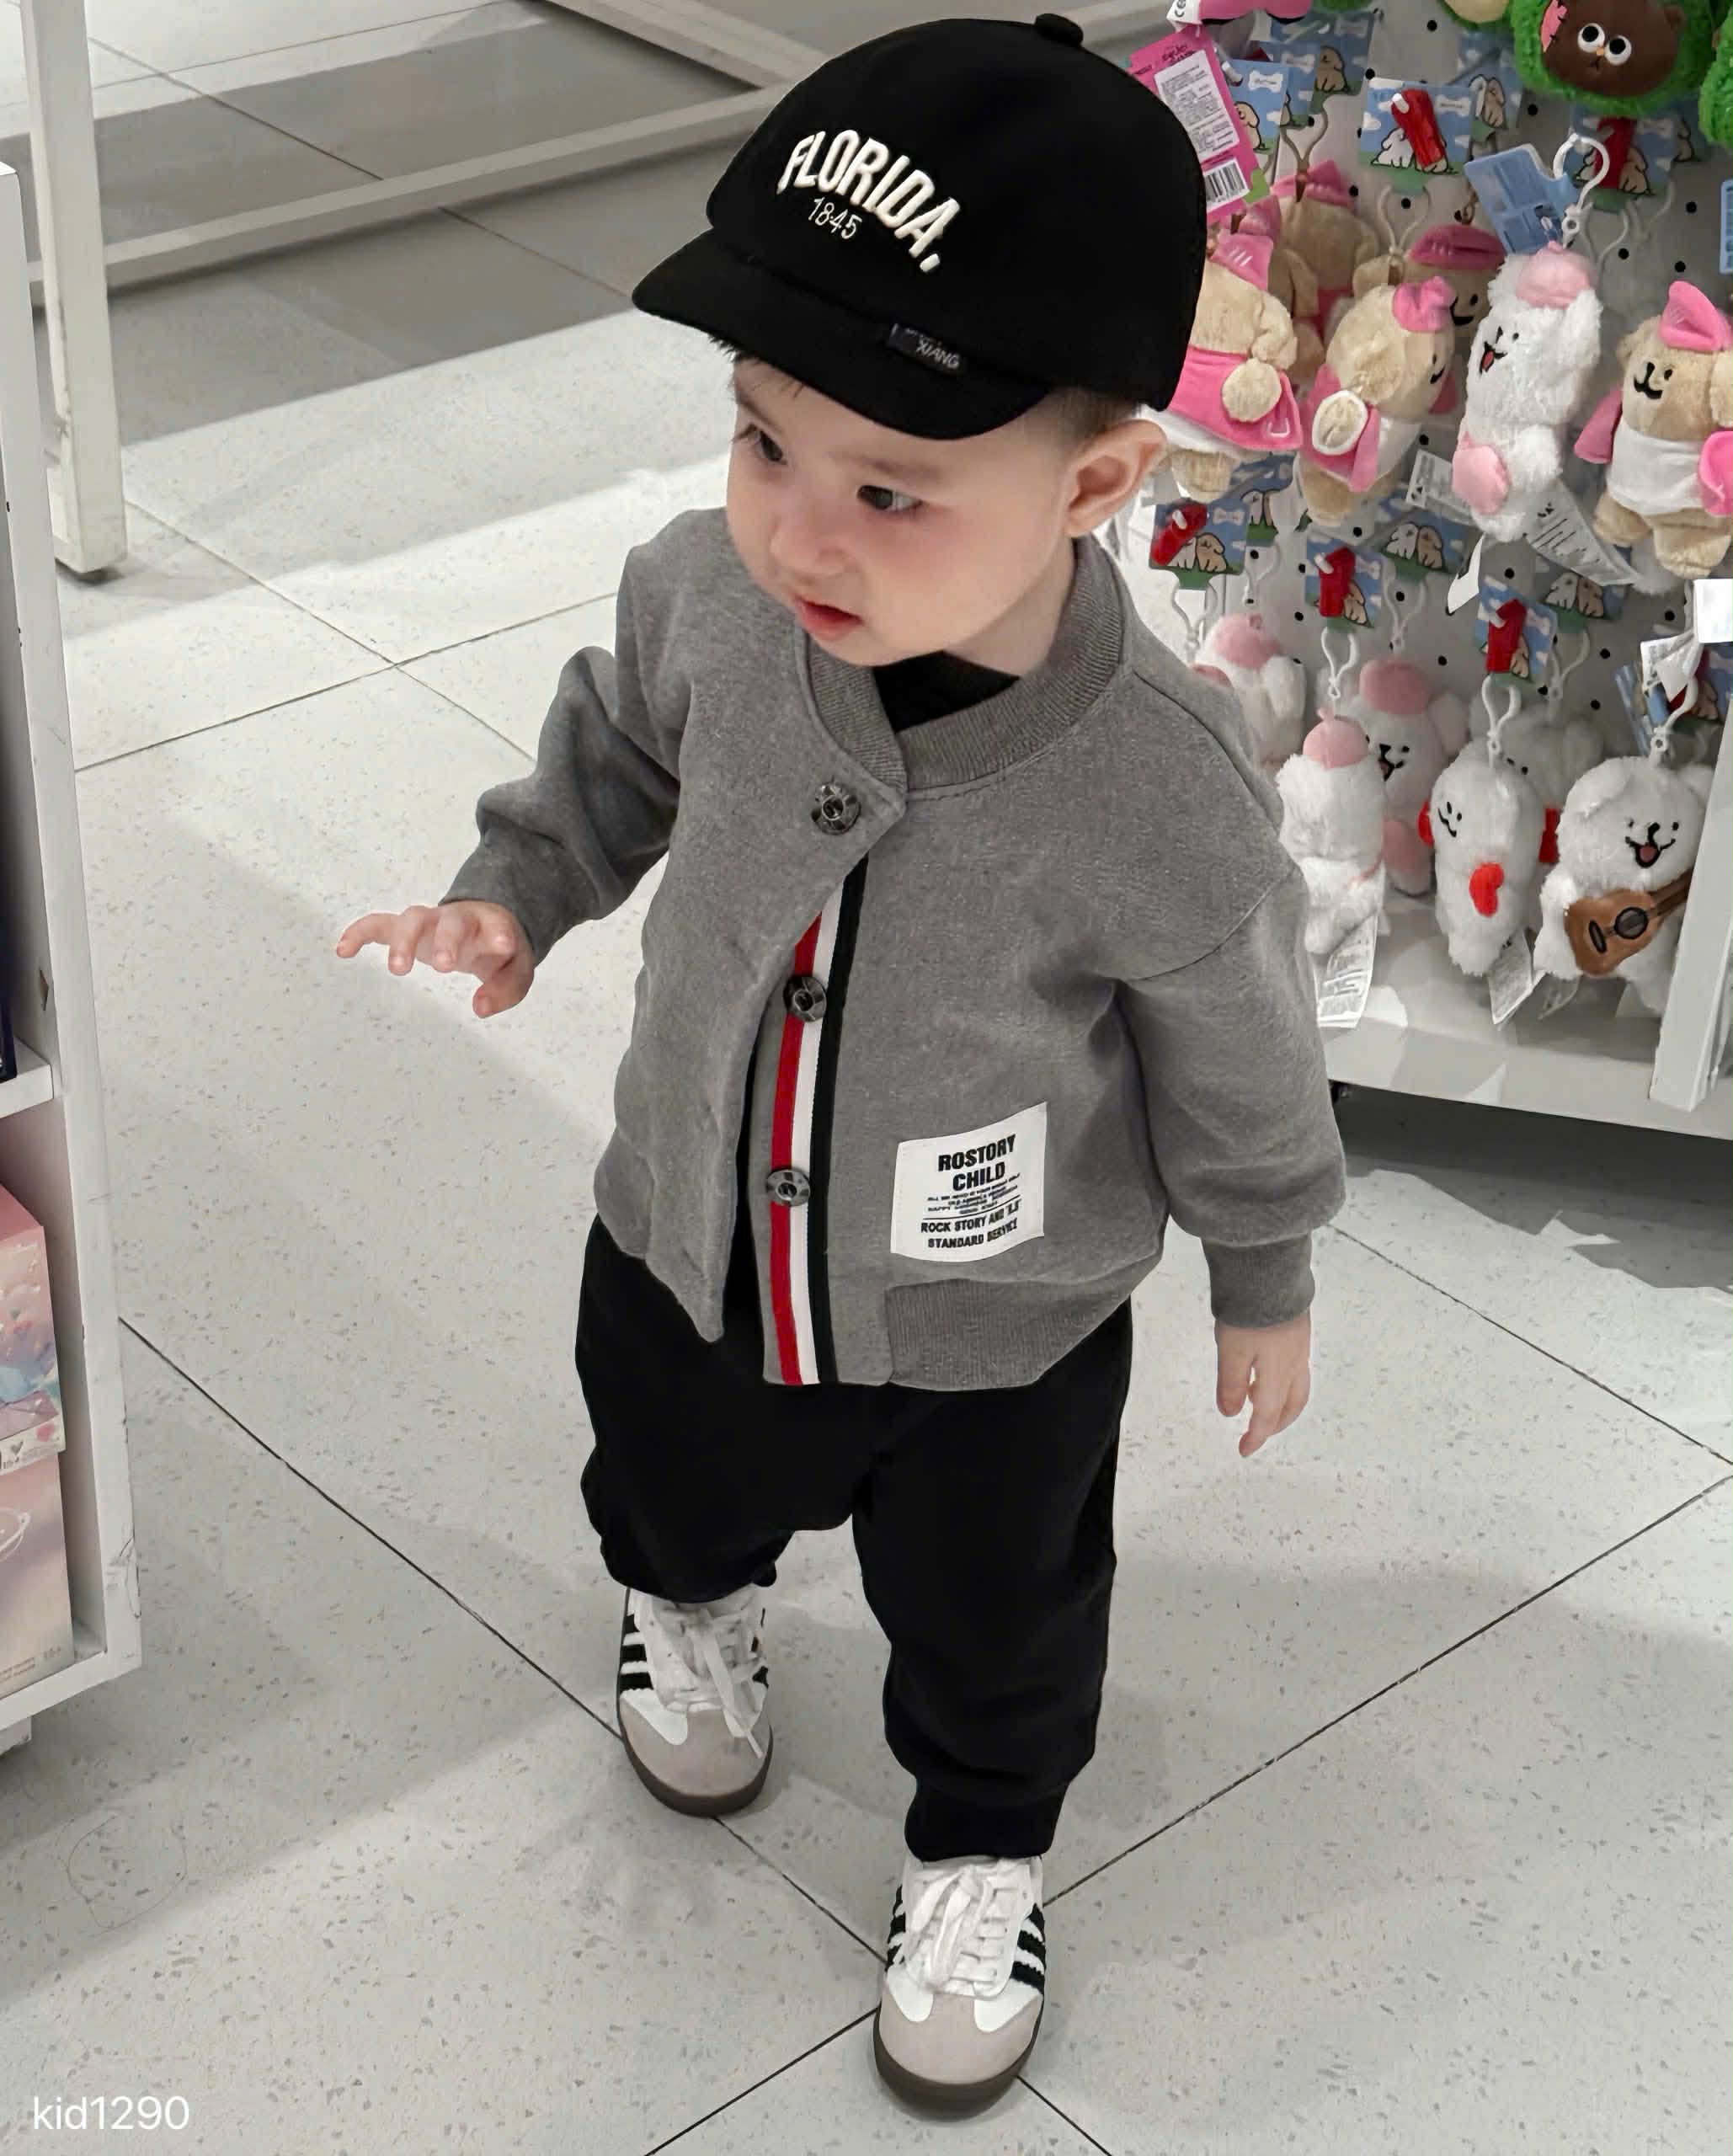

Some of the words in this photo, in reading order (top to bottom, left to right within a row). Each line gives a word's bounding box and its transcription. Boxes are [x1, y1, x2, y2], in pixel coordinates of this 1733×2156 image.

[808, 197, 862, 239] 1845
[938, 1134, 1016, 1171] ROSTORY
[952, 1161, 1005, 1192] CHILD
[920, 1222, 952, 1234] ROCK
[954, 1215, 987, 1232] STORY
[928, 1234, 984, 1248] STANDARD
